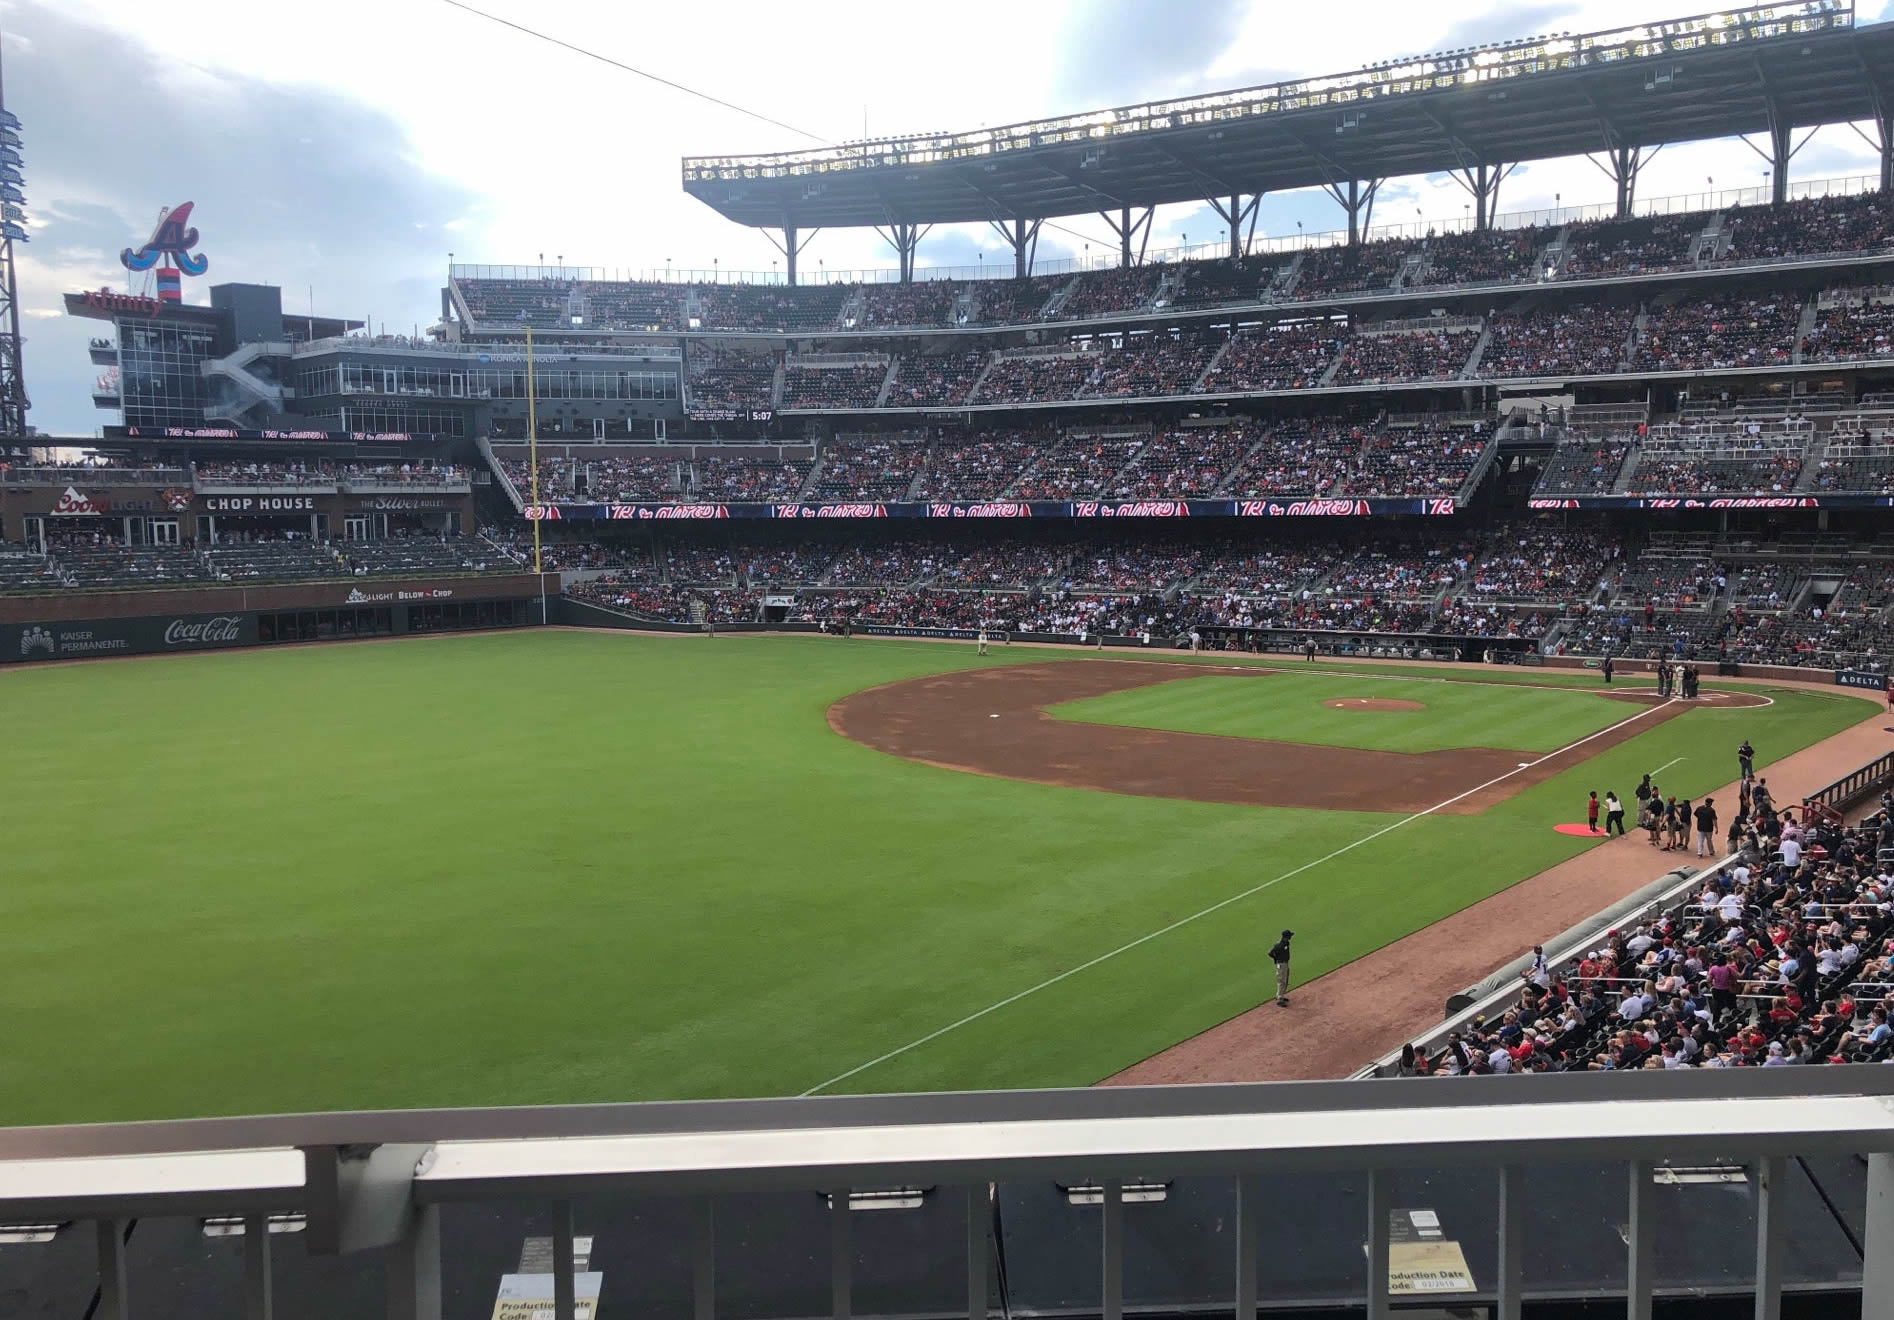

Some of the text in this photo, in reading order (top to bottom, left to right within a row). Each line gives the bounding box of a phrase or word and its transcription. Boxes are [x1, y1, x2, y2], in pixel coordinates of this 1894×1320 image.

[84, 287, 165, 319] xfinity
[490, 354, 521, 363] KONICA
[752, 411, 771, 421] 5:07
[111, 499, 153, 511] LIGHT
[207, 498, 313, 510] CHOP HOUSE
[361, 500, 374, 508] THE
[375, 496, 419, 510] Silver
[164, 616, 243, 644] Coca-Cola
[60, 631, 93, 641] KAISER
[61, 639, 127, 651] PERMANENTE
[1850, 676, 1879, 686] DELTA
[1390, 1270, 1465, 1280] oduction Date
[501, 1301, 591, 1311] Productio ate
